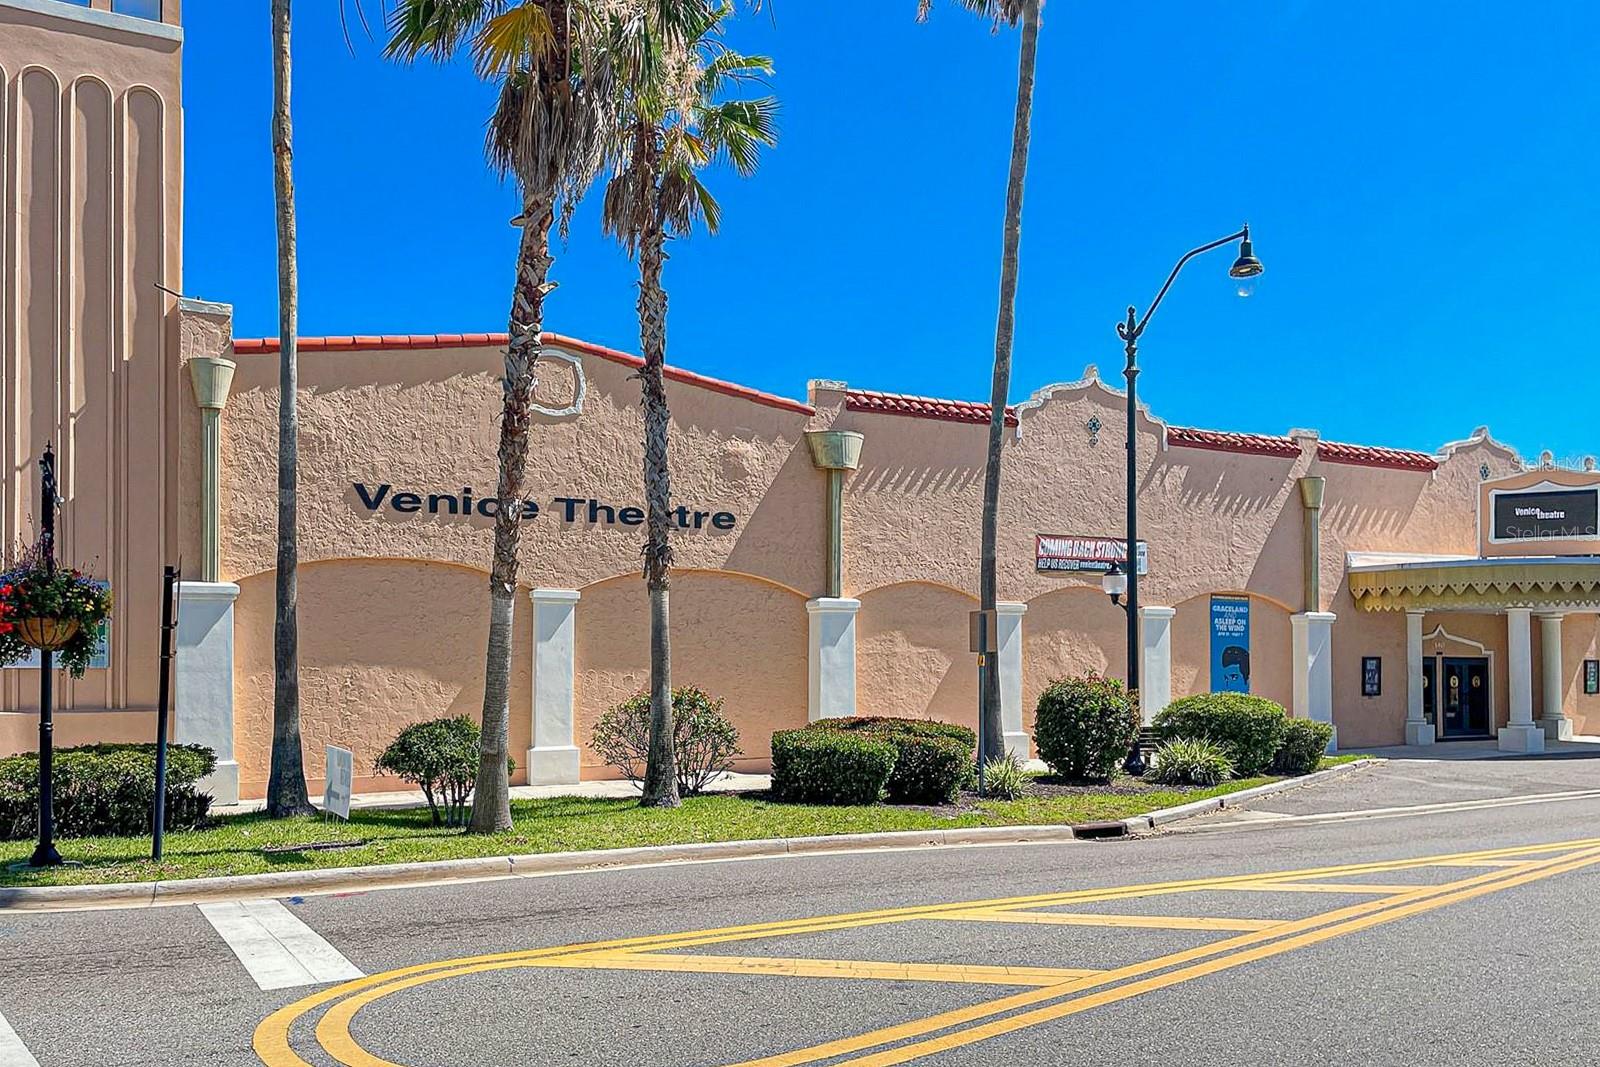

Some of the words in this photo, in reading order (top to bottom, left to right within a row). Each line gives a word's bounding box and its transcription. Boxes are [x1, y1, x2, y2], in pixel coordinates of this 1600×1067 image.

[353, 483, 539, 520] Venice
[555, 497, 736, 530] Thetre
[1039, 538, 1073, 557] COMING
[1073, 540, 1096, 559] BACK
[1095, 540, 1128, 560] STRONG
[1038, 557, 1051, 569] HELP
[1050, 558, 1059, 569] US
[1058, 559, 1080, 570] RECOVER
[1212, 605, 1249, 613] GRACELAND
